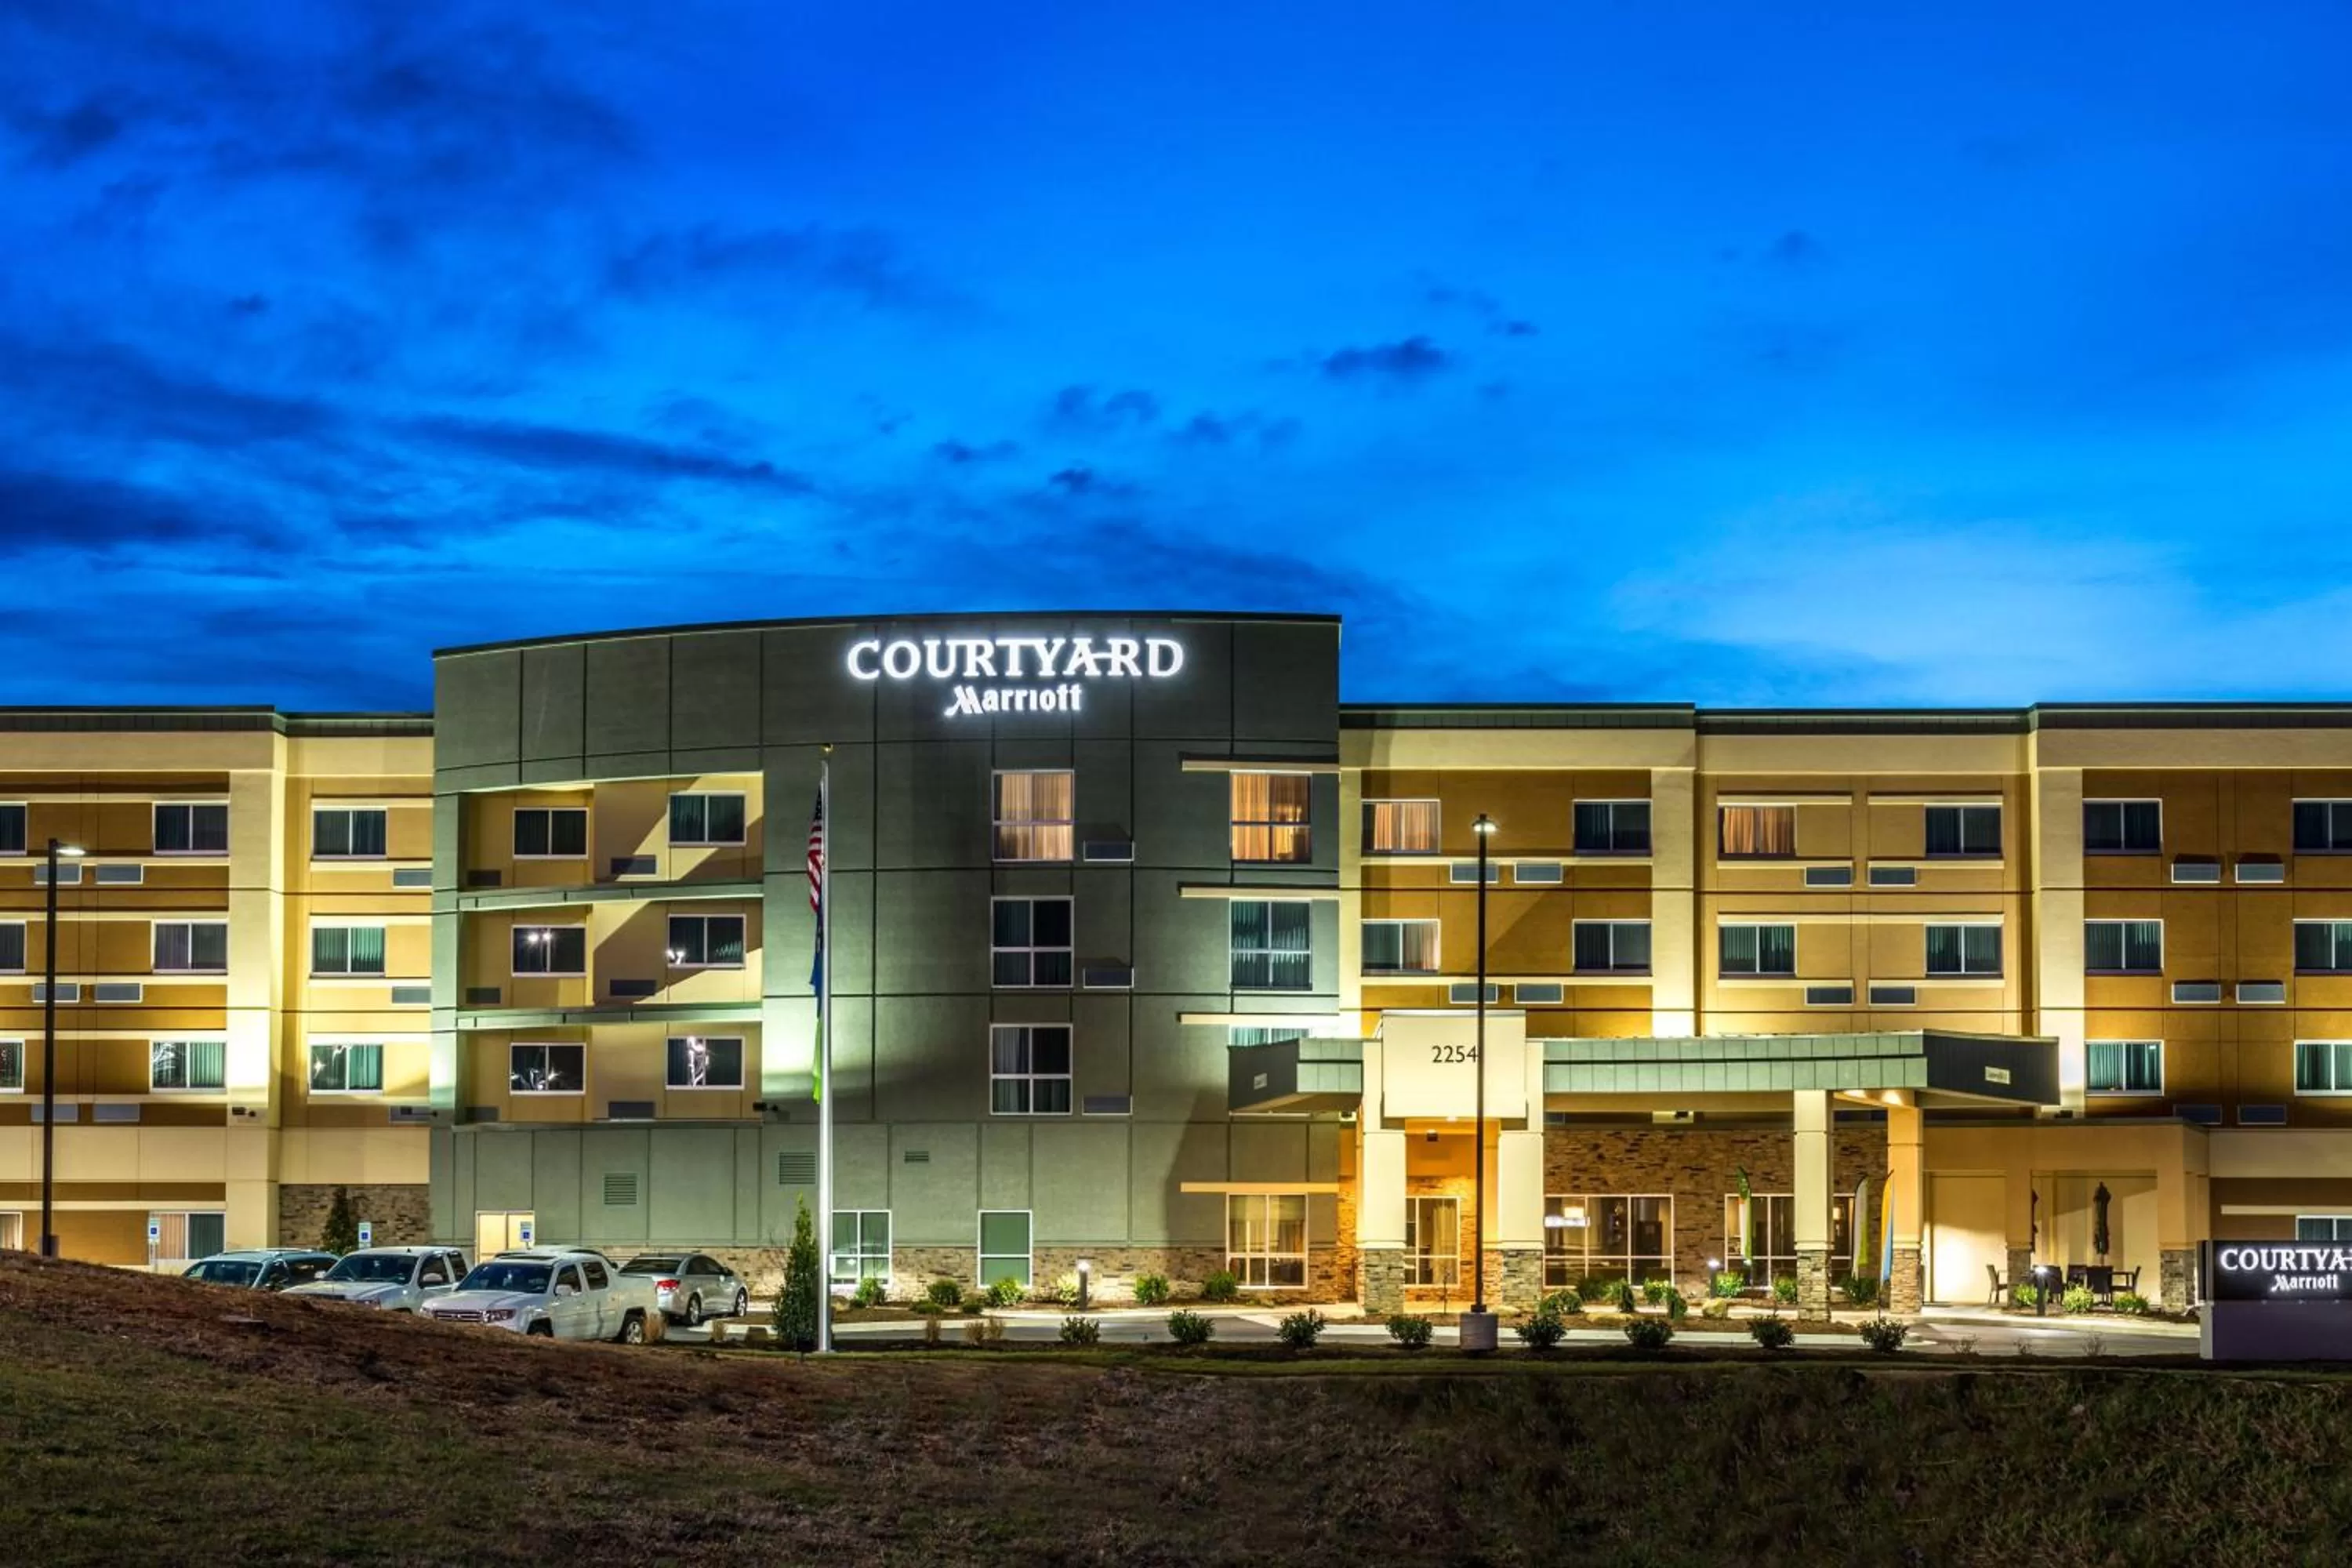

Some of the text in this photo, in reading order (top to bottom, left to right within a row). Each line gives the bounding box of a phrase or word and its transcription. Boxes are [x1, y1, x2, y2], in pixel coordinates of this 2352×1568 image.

[847, 637, 1184, 680] COURTYARD
[944, 684, 1082, 717] Marriott
[1432, 1045, 1479, 1063] 2254
[2220, 1248, 2352, 1271] COURTYA
[2270, 1274, 2338, 1292] Marriott
